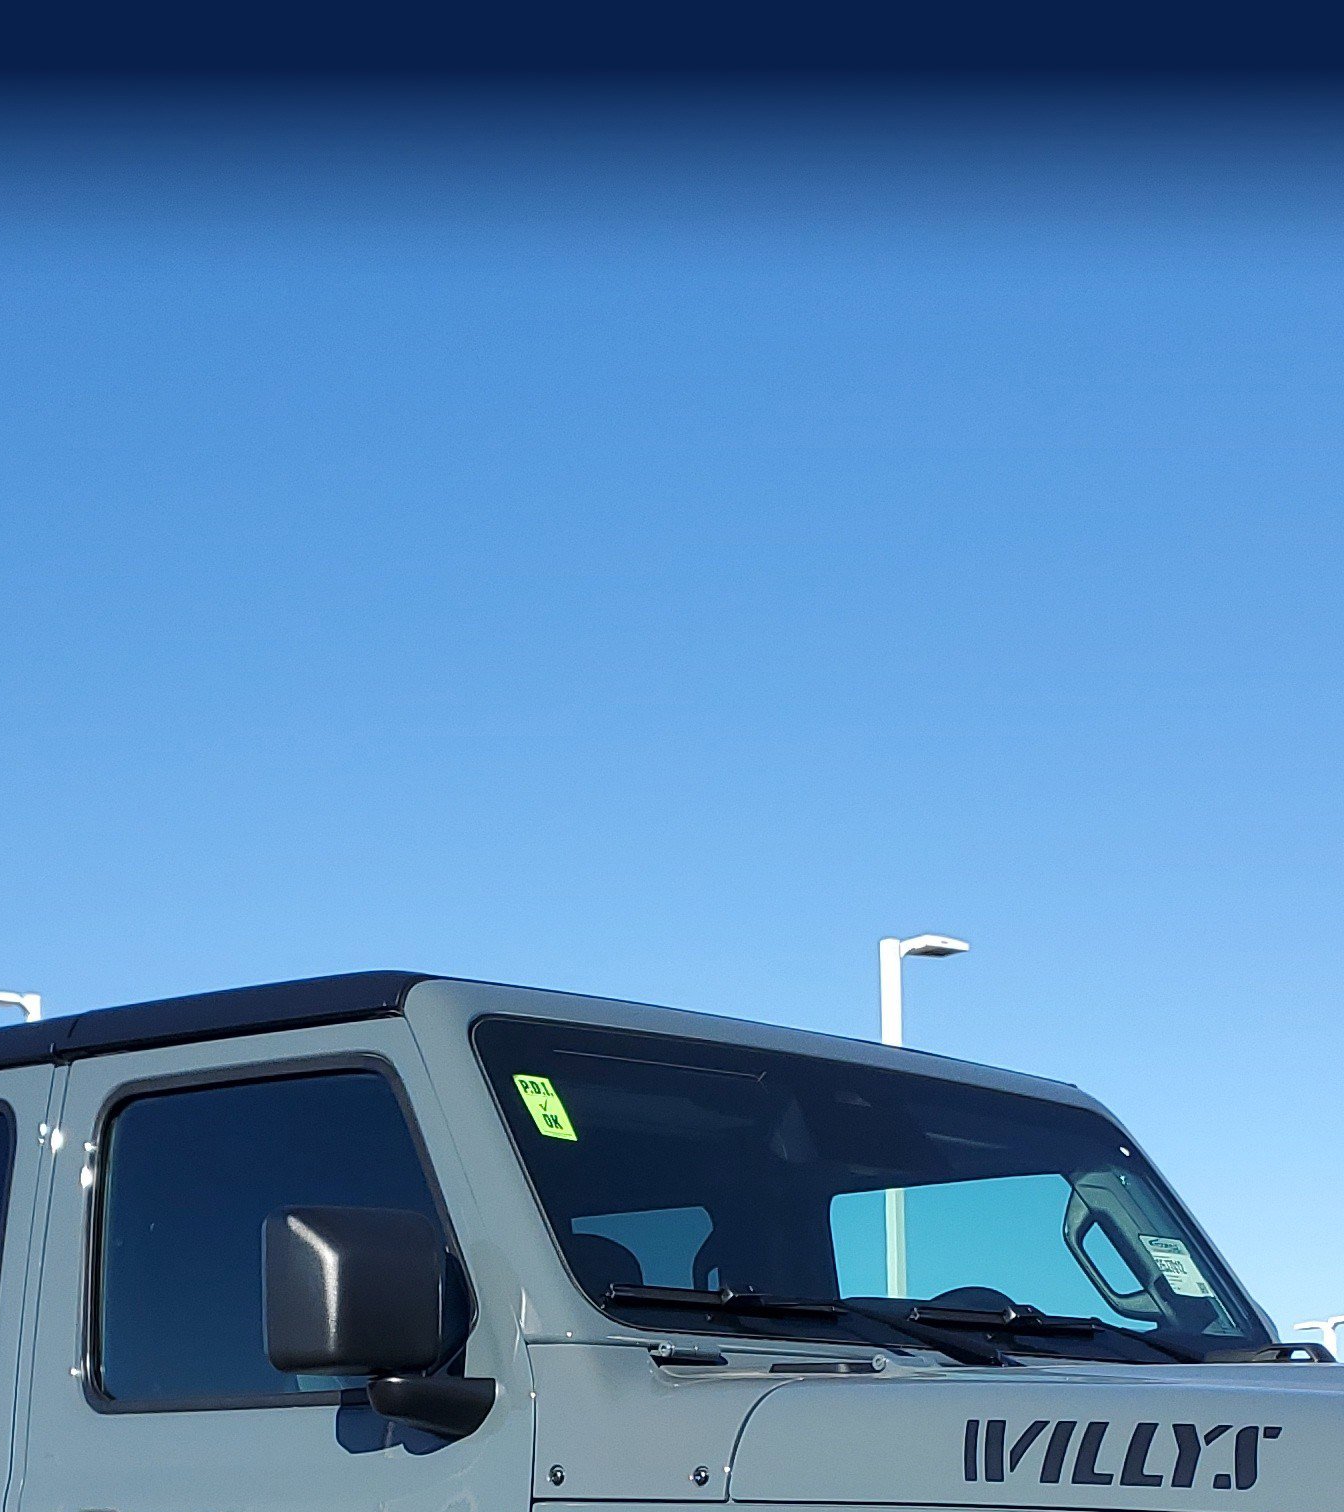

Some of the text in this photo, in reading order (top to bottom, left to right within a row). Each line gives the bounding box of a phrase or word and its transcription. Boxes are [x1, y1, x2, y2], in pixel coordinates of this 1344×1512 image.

[518, 1079, 555, 1097] P.D.I.
[542, 1113, 564, 1130] OK
[963, 1419, 1283, 1490] WILLYS
